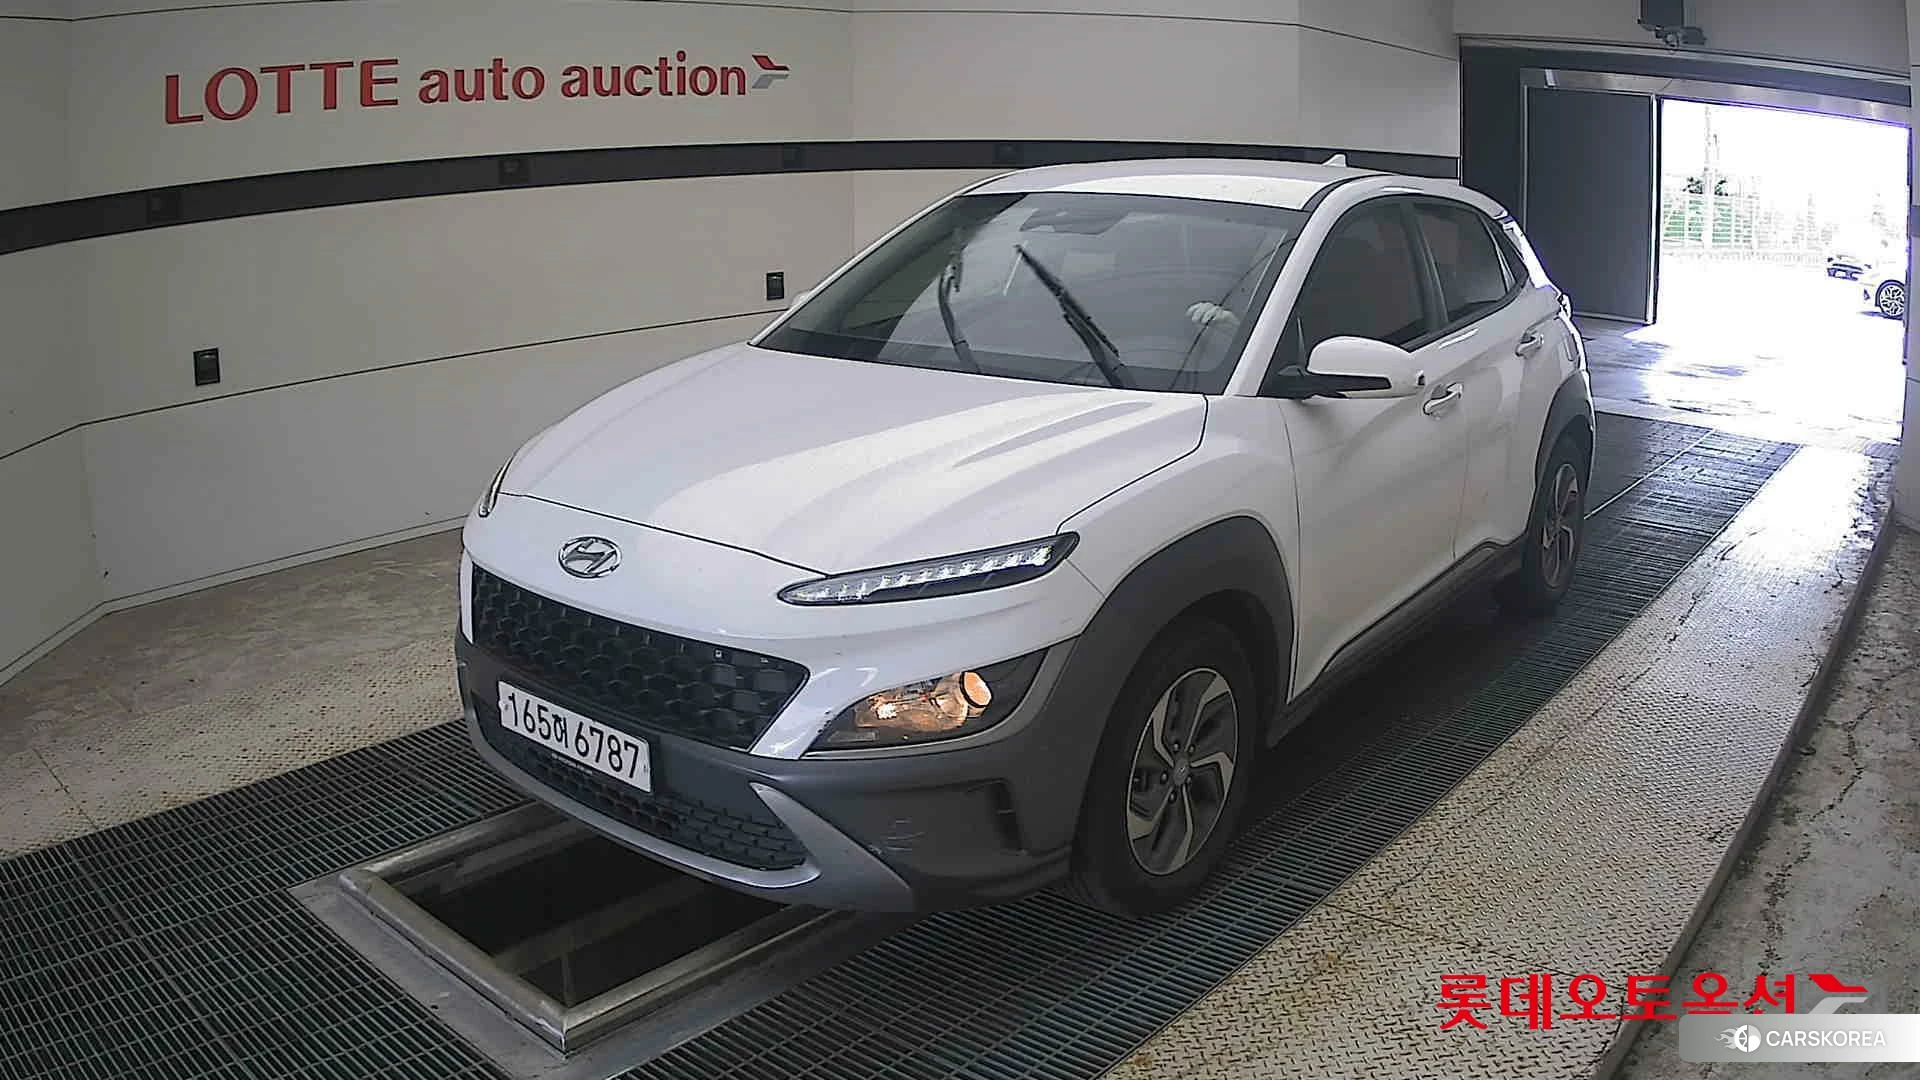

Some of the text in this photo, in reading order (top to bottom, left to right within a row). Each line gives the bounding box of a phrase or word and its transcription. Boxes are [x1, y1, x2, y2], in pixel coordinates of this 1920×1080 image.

[165, 50, 748, 125] LOTTE auto auction
[574, 721, 640, 779] 6787
